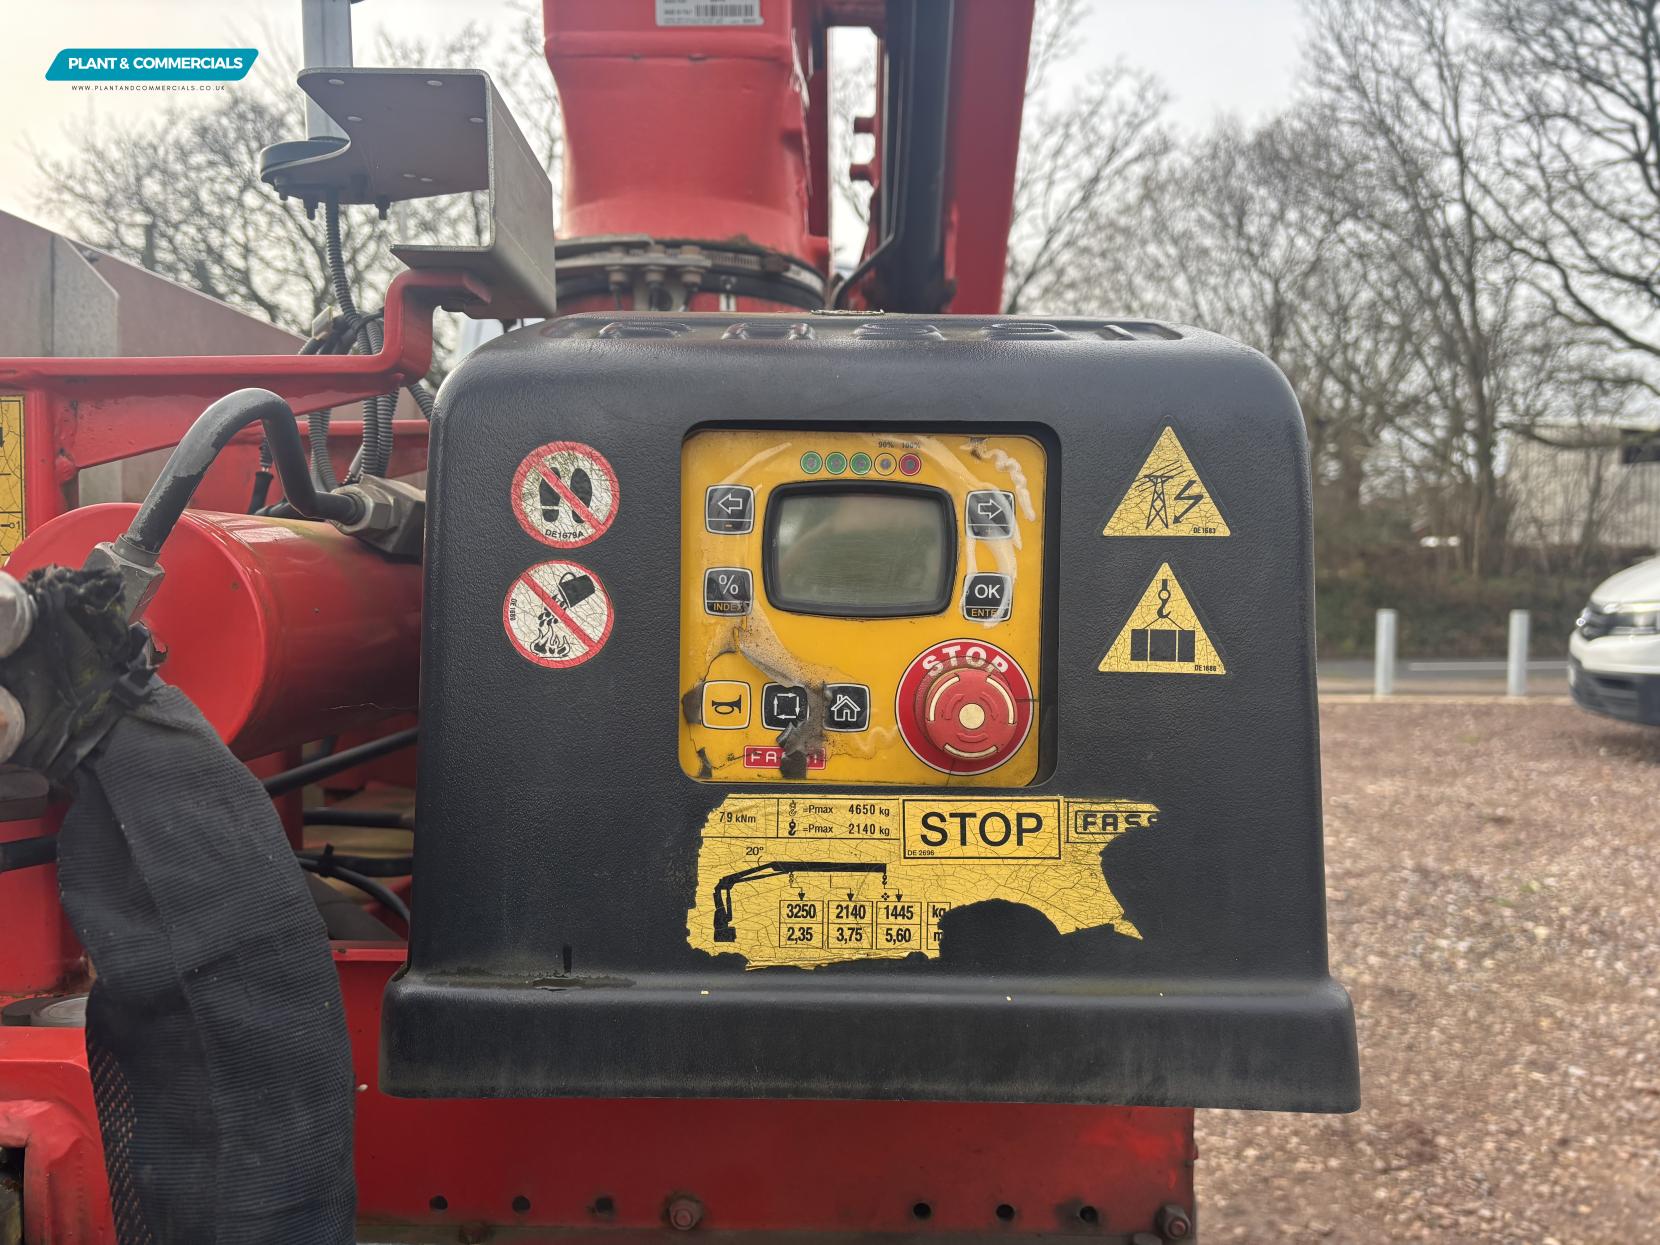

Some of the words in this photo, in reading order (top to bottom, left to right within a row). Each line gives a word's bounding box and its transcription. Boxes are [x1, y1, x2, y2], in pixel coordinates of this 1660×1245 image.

[718, 574, 739, 594] %
[974, 584, 1001, 599] OK
[713, 602, 743, 611] INDEX
[971, 608, 1003, 617] ENTE
[922, 645, 1009, 676] STOP
[803, 804, 833, 814] =Pmax
[848, 804, 876, 815] 4650
[879, 806, 890, 817] kg
[735, 814, 756, 823] kNm
[803, 824, 833, 834] =Pmax
[848, 824, 876, 835] 2140
[879, 826, 890, 836] kg
[920, 811, 1043, 847] STOP
[745, 847, 764, 856] 20°
[786, 903, 817, 919] 3250
[835, 904, 867, 920] 2140
[884, 905, 914, 920] 1445
[786, 926, 813, 944] 2,35
[836, 927, 863, 944] 3,75
[885, 928, 912, 945] 5,60
